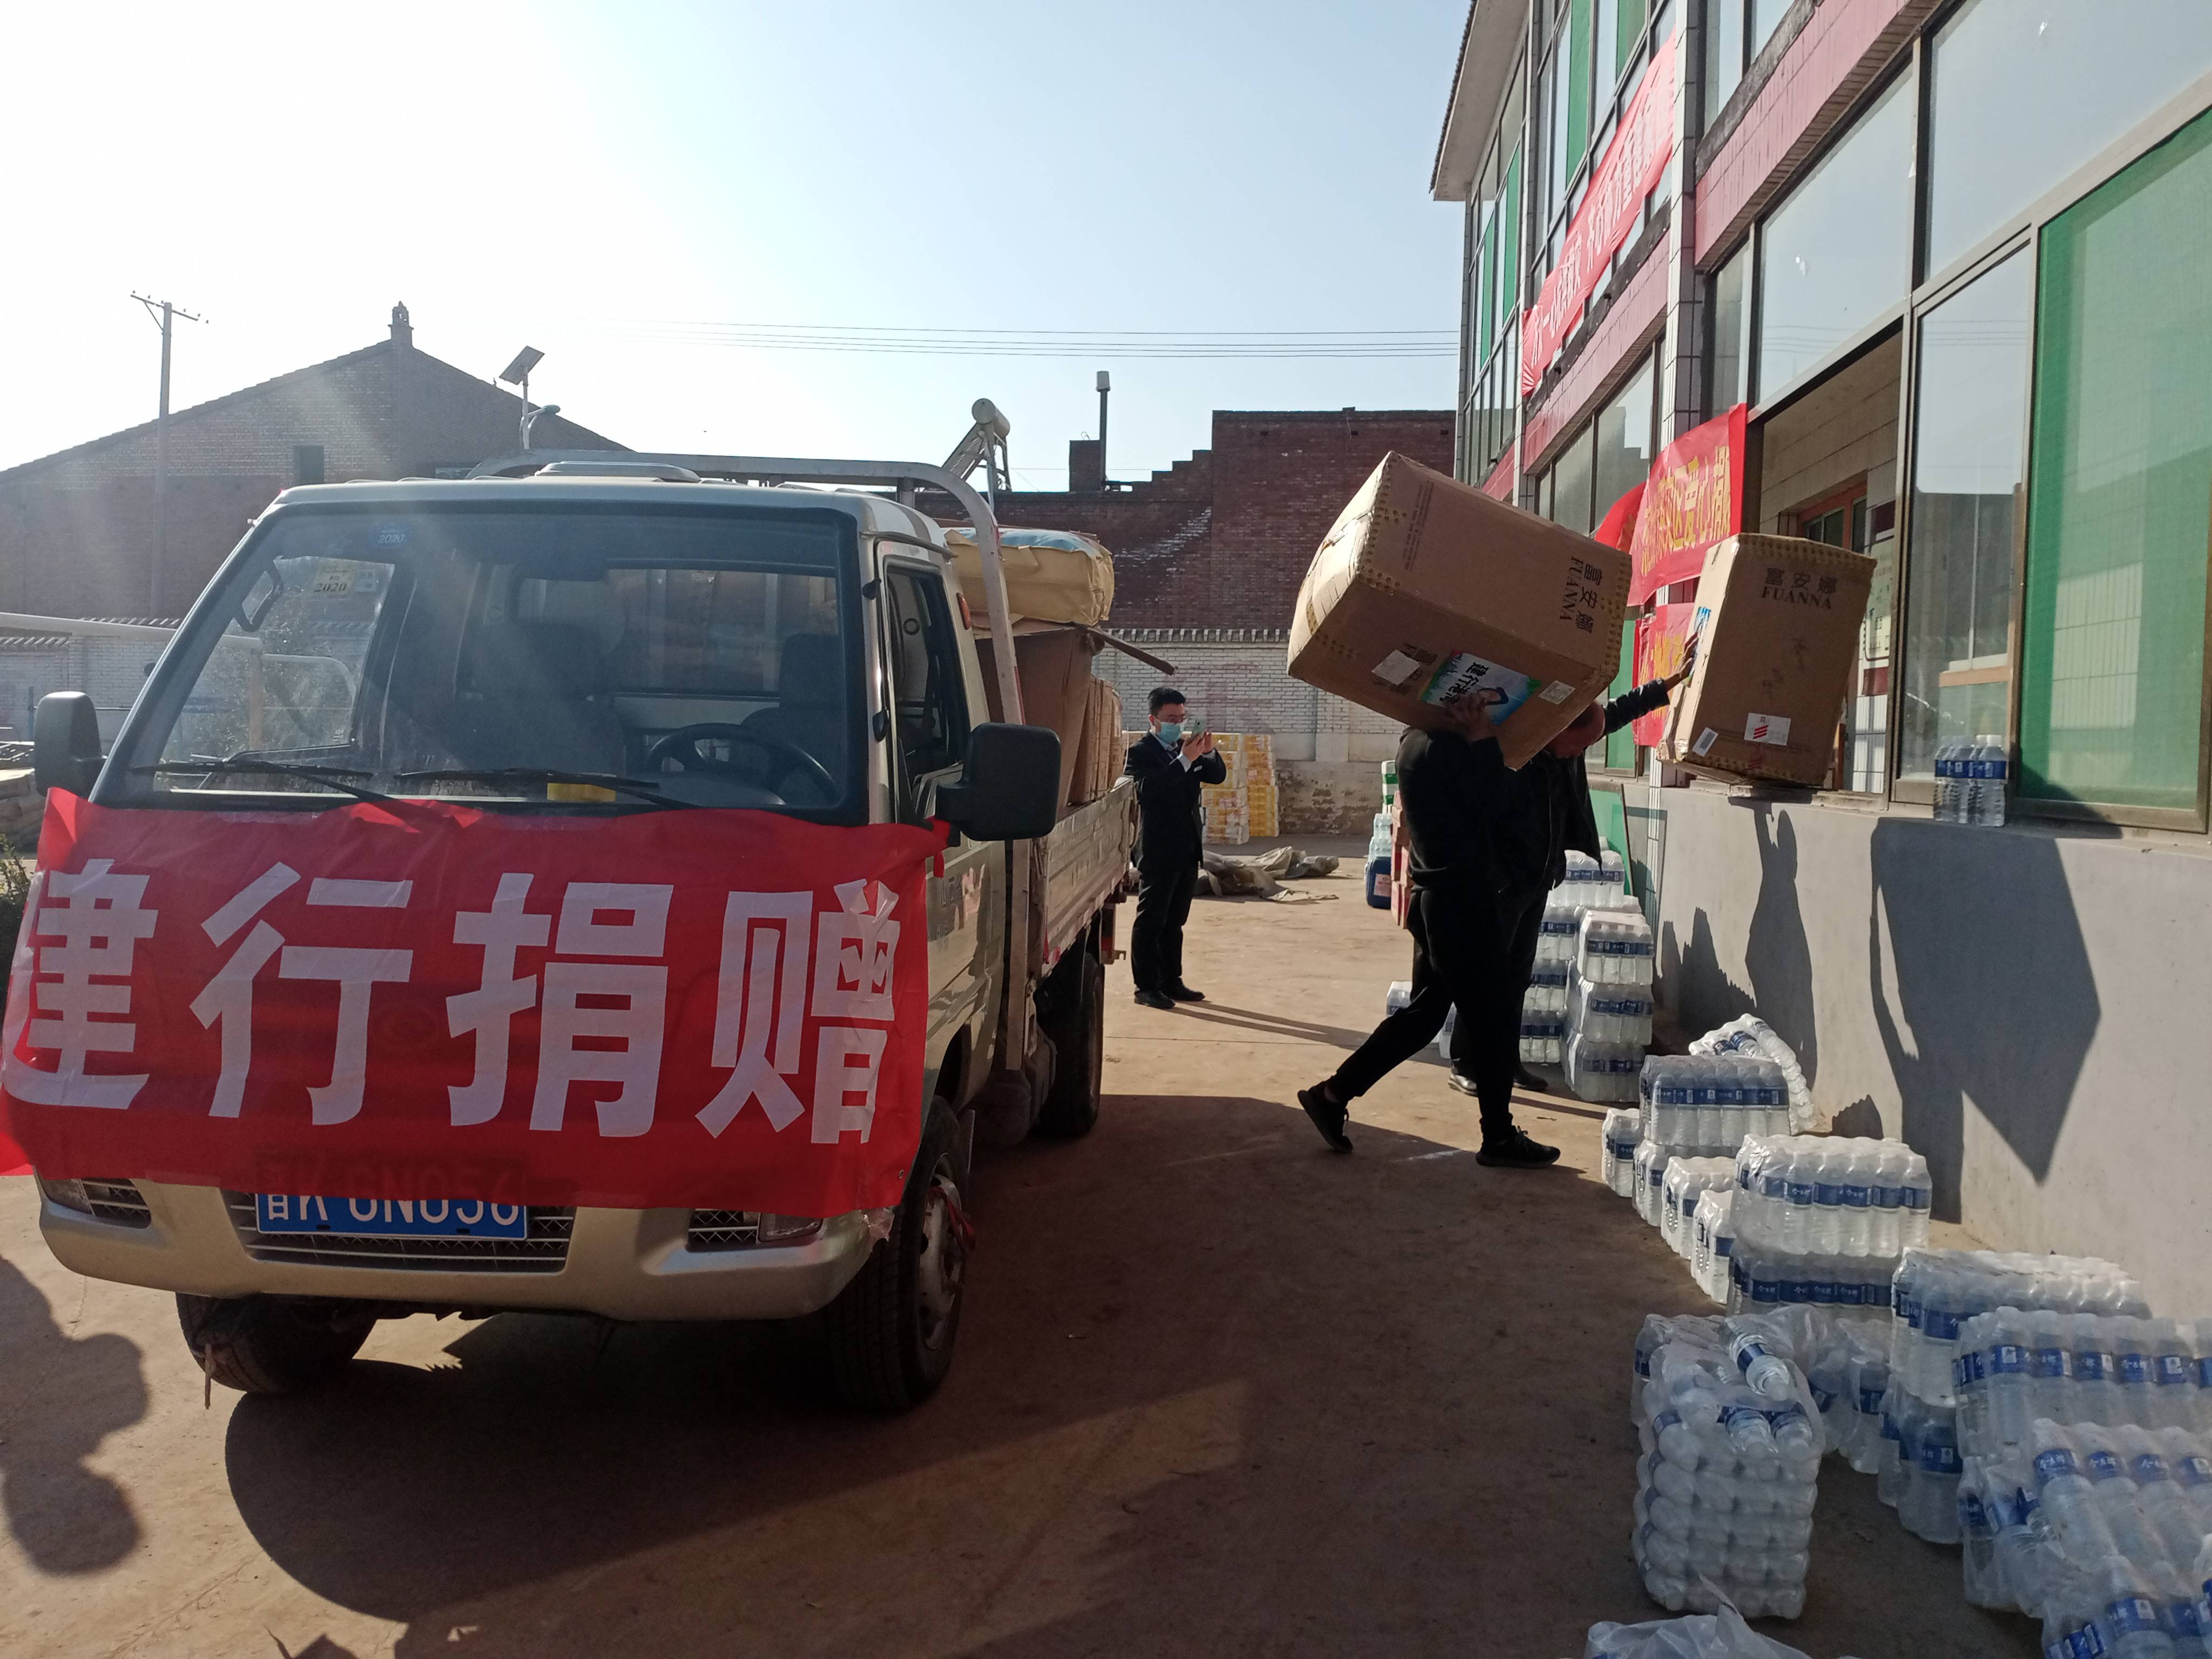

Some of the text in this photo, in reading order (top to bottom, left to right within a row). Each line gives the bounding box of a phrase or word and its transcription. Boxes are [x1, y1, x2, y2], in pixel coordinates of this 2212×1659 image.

[1560, 555, 1583, 620] FUANNA
[1574, 564, 1602, 633] 富安娜
[1762, 586, 1831, 609] FUANNA
[1764, 568, 1836, 594] 富安娜
[1, 859, 900, 1144] 建行捐赠
